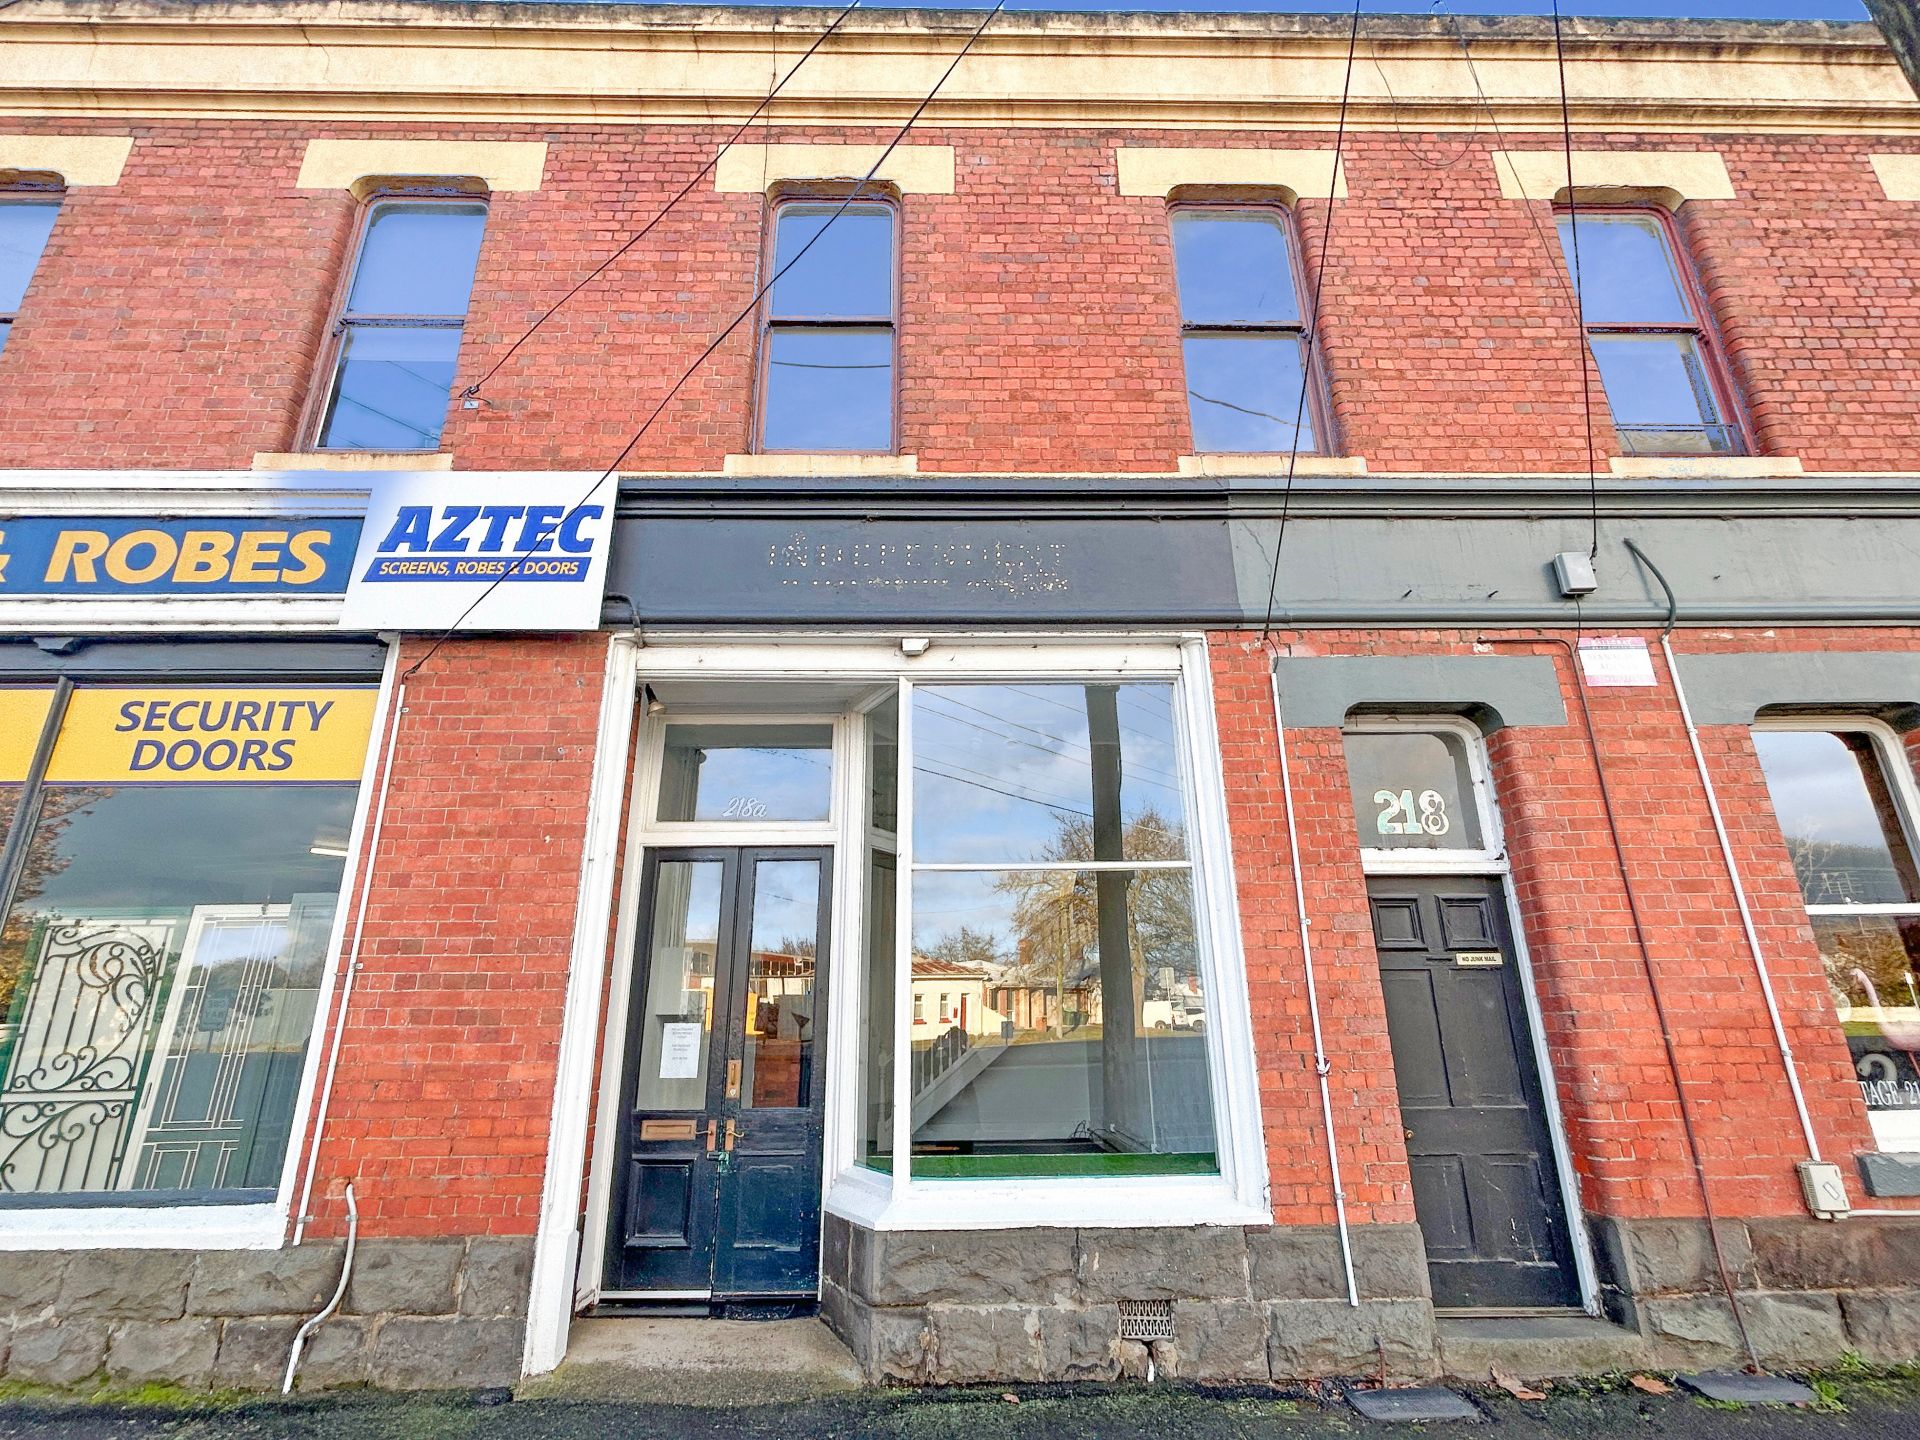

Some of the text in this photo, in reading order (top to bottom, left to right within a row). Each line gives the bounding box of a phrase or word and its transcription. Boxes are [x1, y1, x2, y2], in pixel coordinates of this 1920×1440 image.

[377, 505, 605, 553] AZTEC
[44, 529, 332, 585] ROBES
[379, 561, 579, 576] SCREENS, ROBES & DOORS
[115, 701, 334, 731] SECURITY
[129, 739, 296, 771] DOORS
[722, 797, 767, 818] 218a
[1373, 789, 1449, 836] 218
